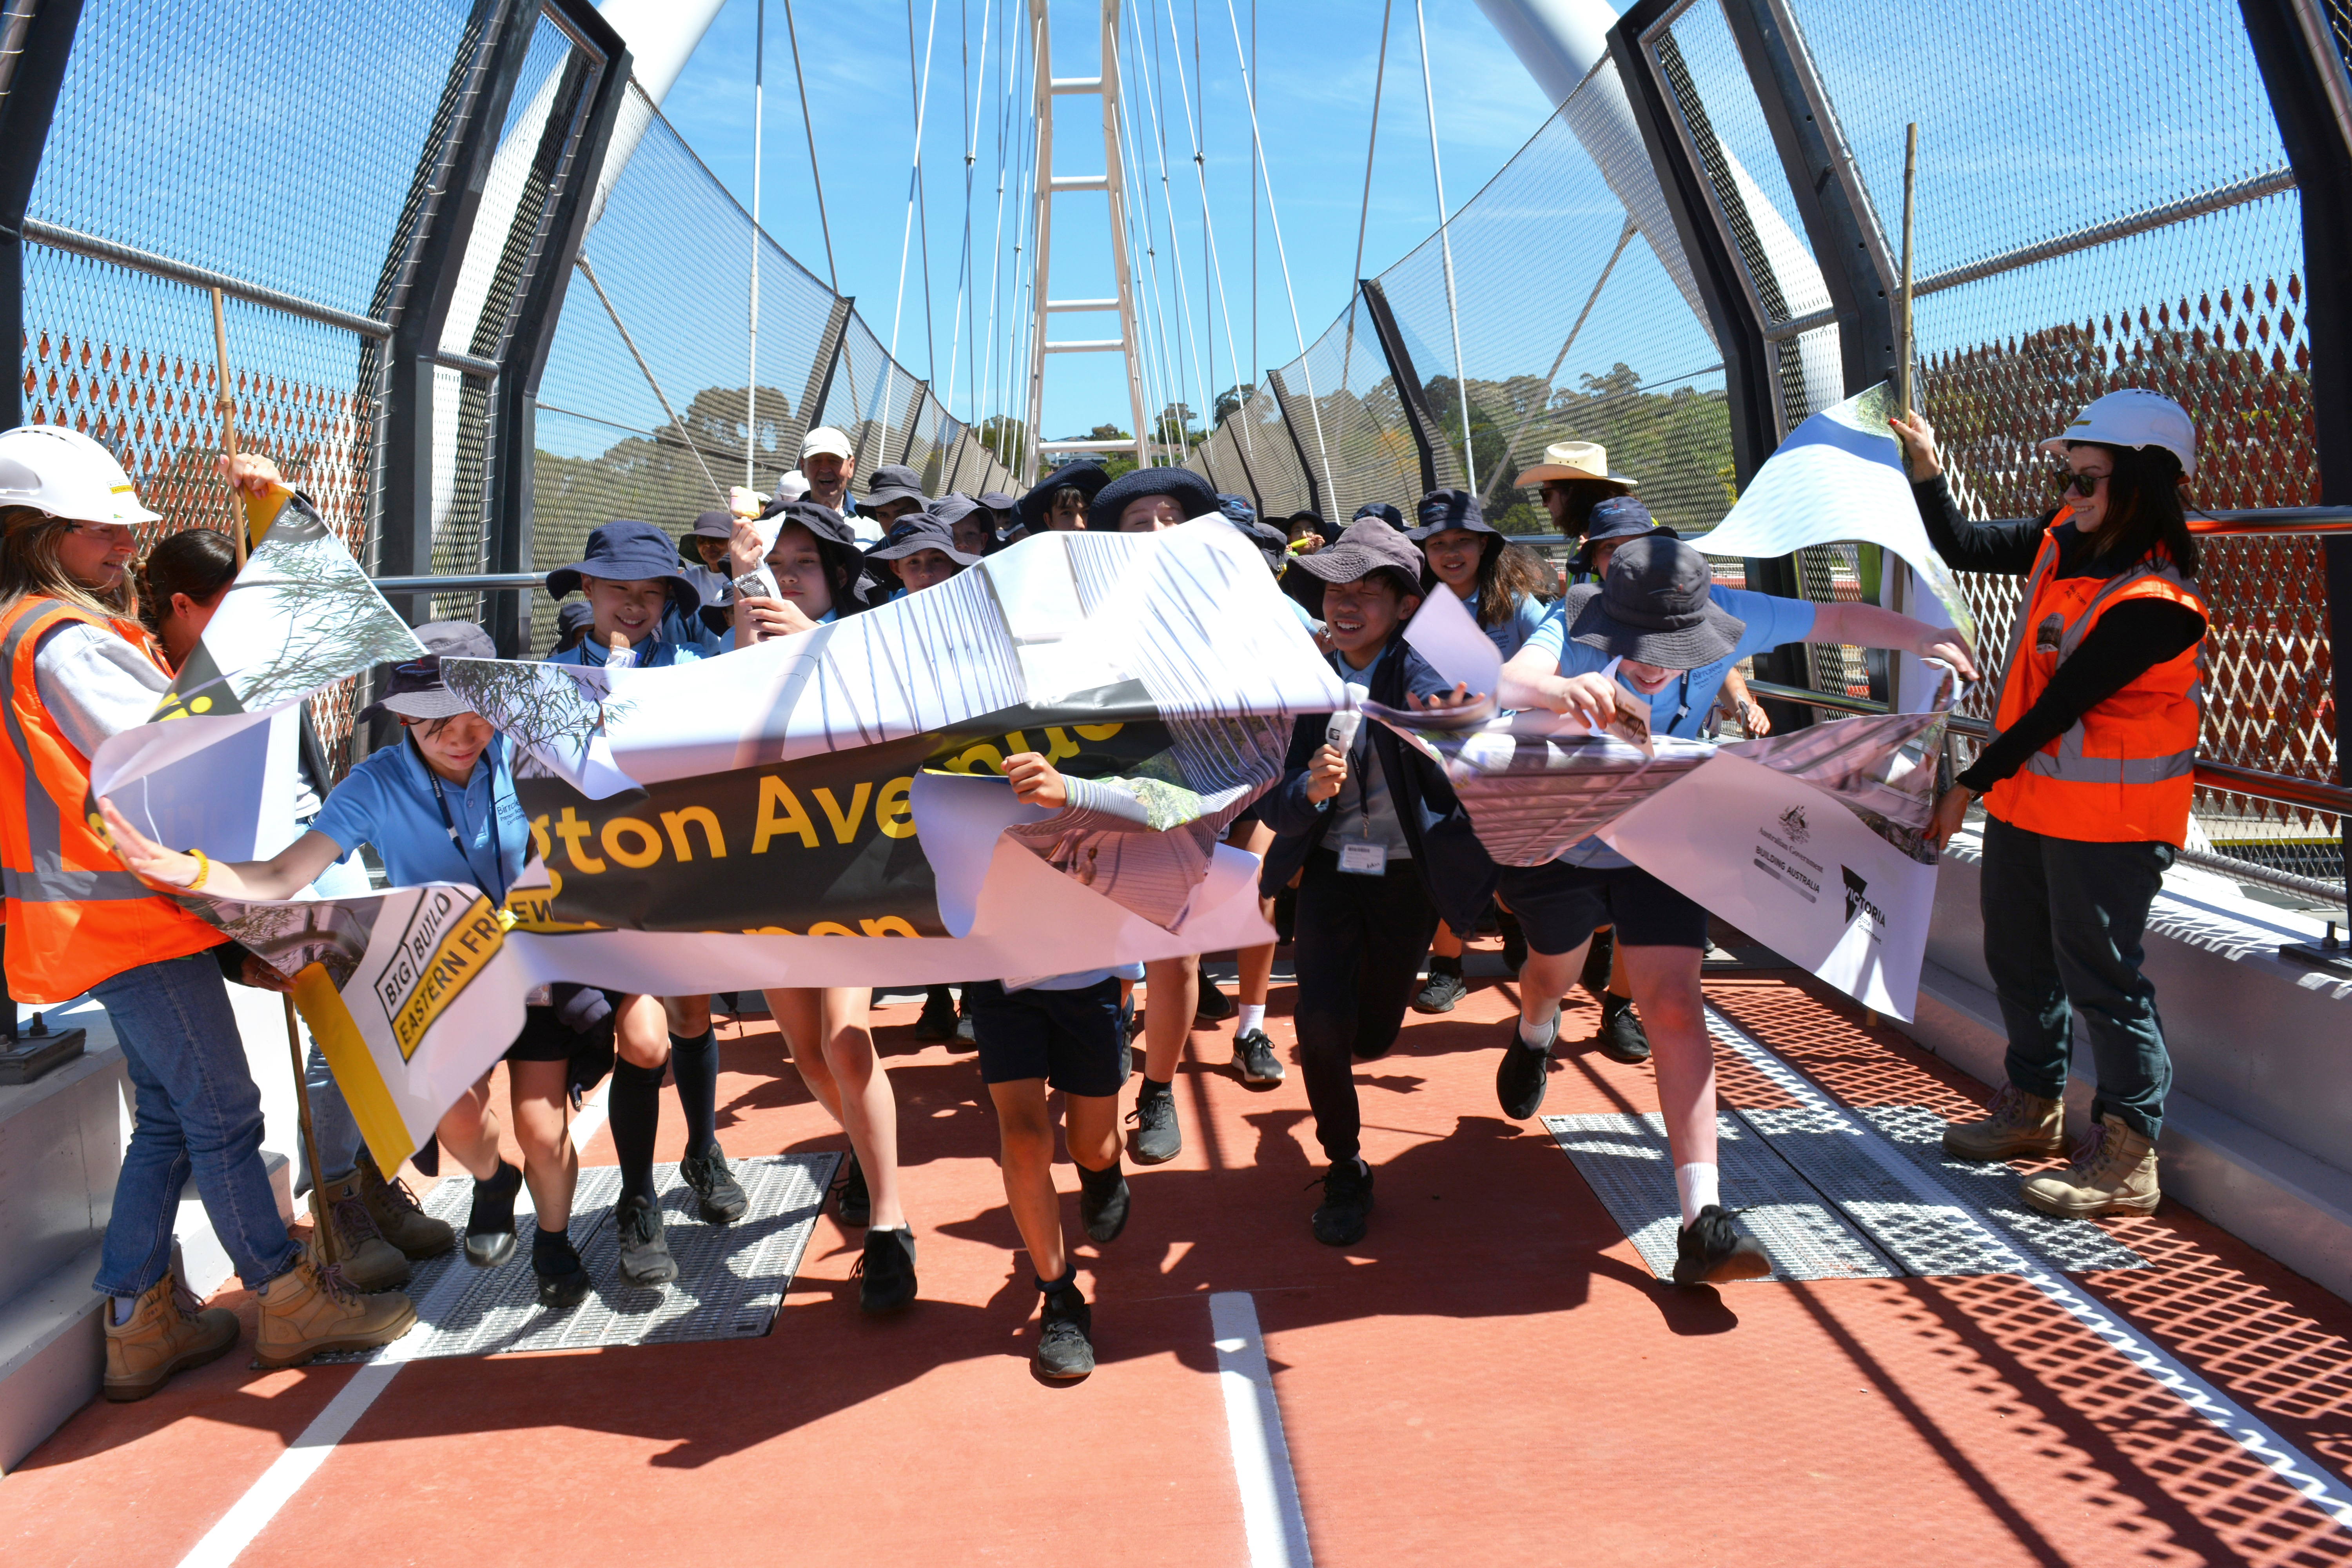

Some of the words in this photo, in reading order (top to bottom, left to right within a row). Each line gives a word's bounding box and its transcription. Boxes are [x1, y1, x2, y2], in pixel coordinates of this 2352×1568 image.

[1756, 845, 1785, 870] BUILDING
[1786, 866, 1819, 893] AUSTRALIA
[1758, 827, 1788, 851] Australian
[1789, 846, 1823, 873] Government
[1844, 886, 1885, 928] VICTORIA
[1858, 913, 1871, 927] State
[384, 961, 412, 1007] BIG
[413, 891, 450, 960] BUILD
[1857, 921, 1882, 945] Government
[399, 950, 468, 1045] EASTERN
